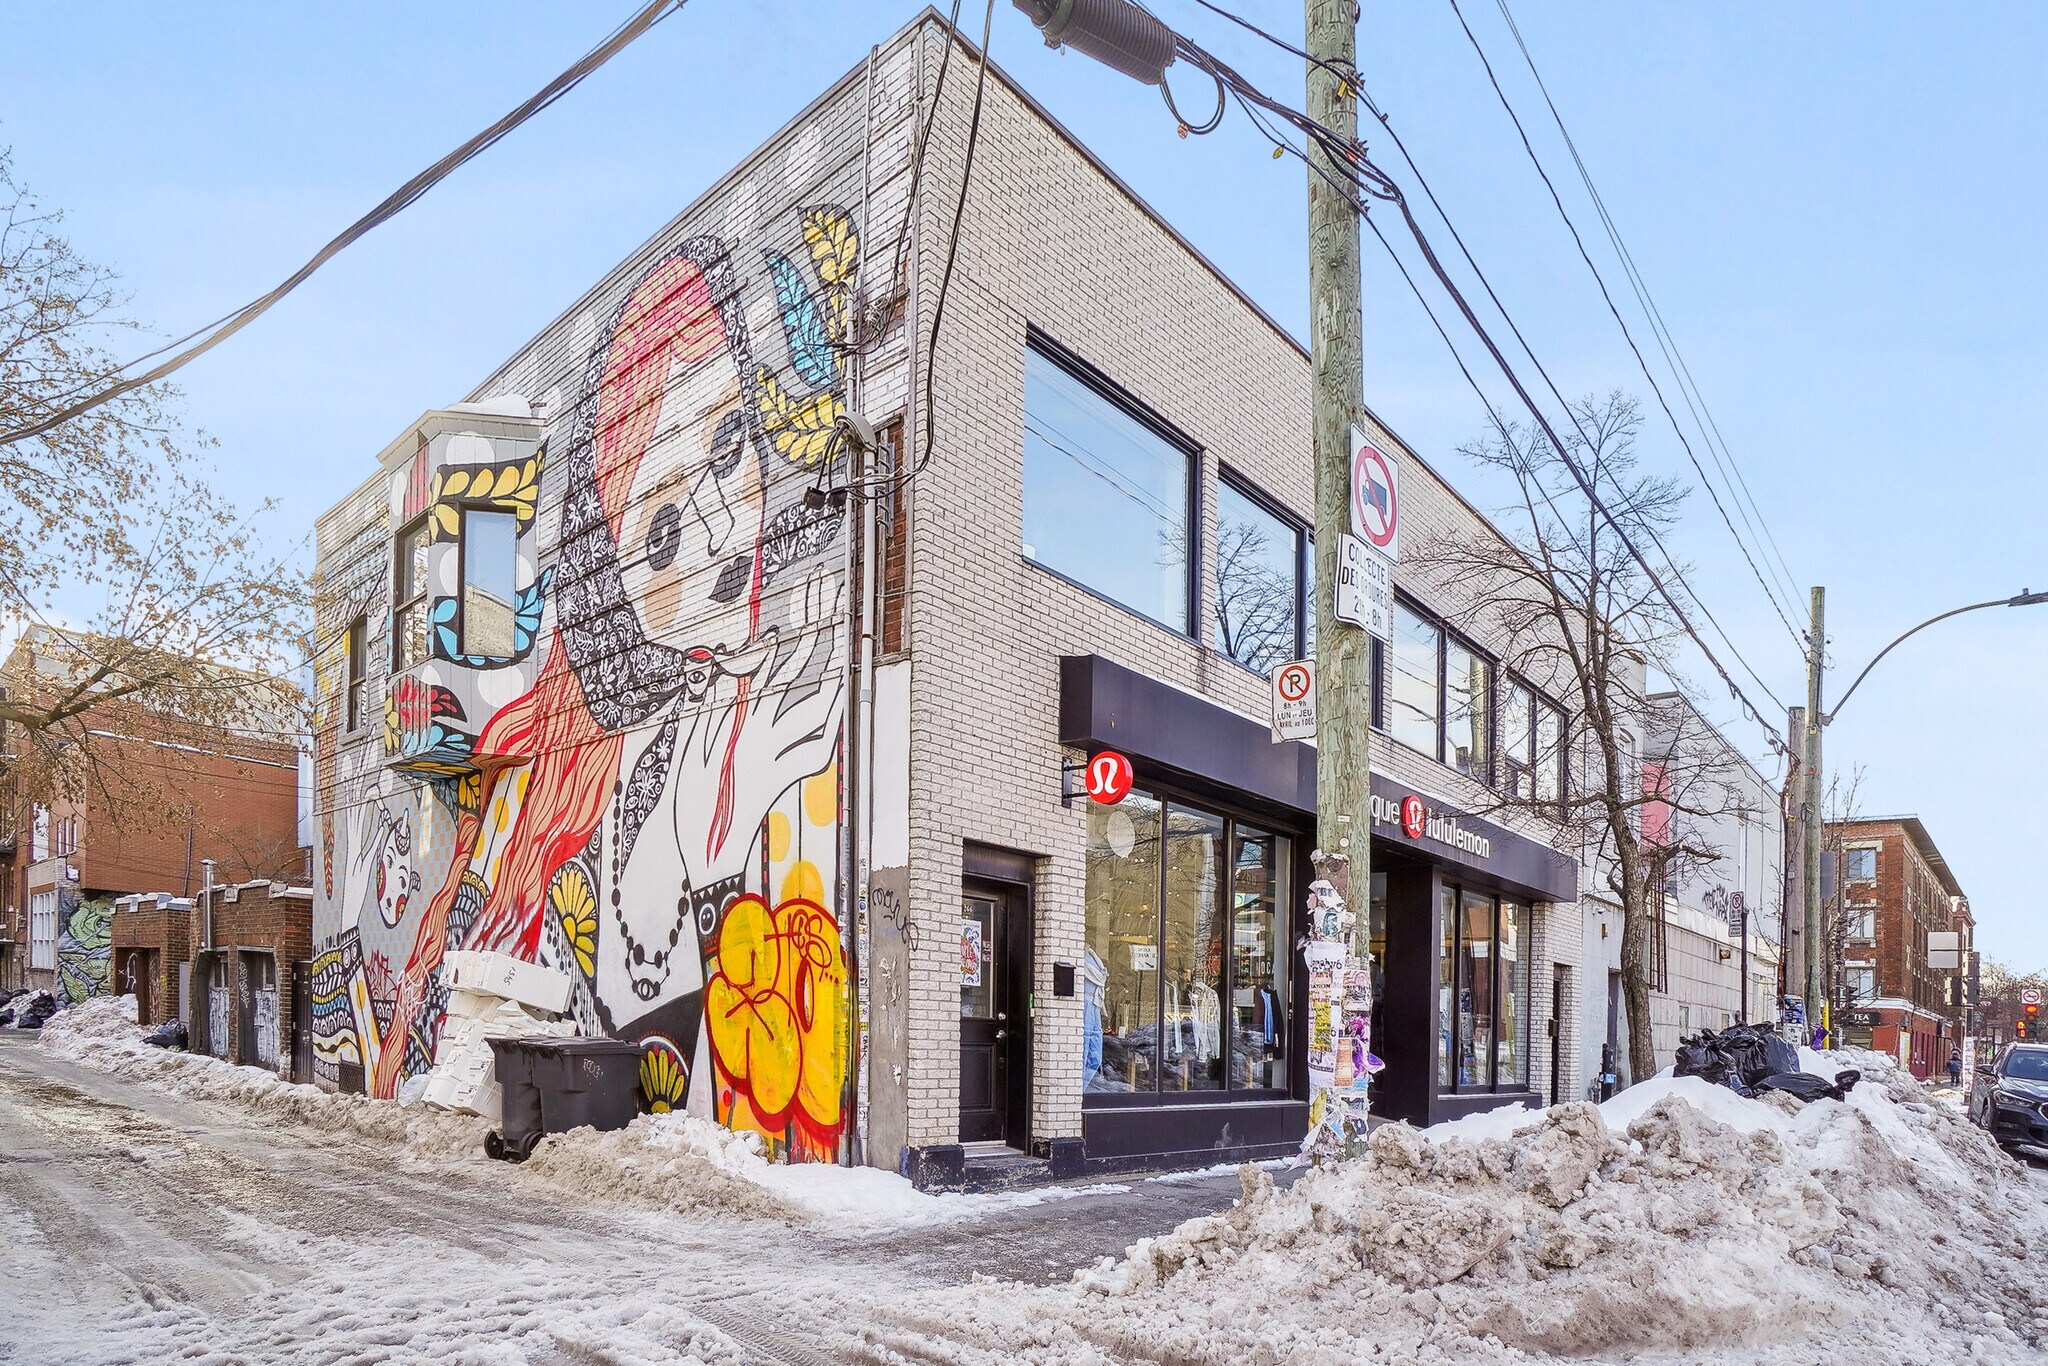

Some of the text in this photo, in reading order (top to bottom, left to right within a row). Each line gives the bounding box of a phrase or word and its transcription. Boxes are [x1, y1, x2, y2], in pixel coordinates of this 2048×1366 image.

[1348, 543, 1386, 585] COLLECTE
[1341, 566, 1359, 590] DES
[1372, 608, 1382, 630] 8h
[1277, 711, 1291, 720] LUN
[1298, 708, 1313, 718] JEU
[1283, 702, 1291, 710] 8h
[1298, 700, 1307, 708] 9h
[1425, 807, 1490, 859] lululemon
